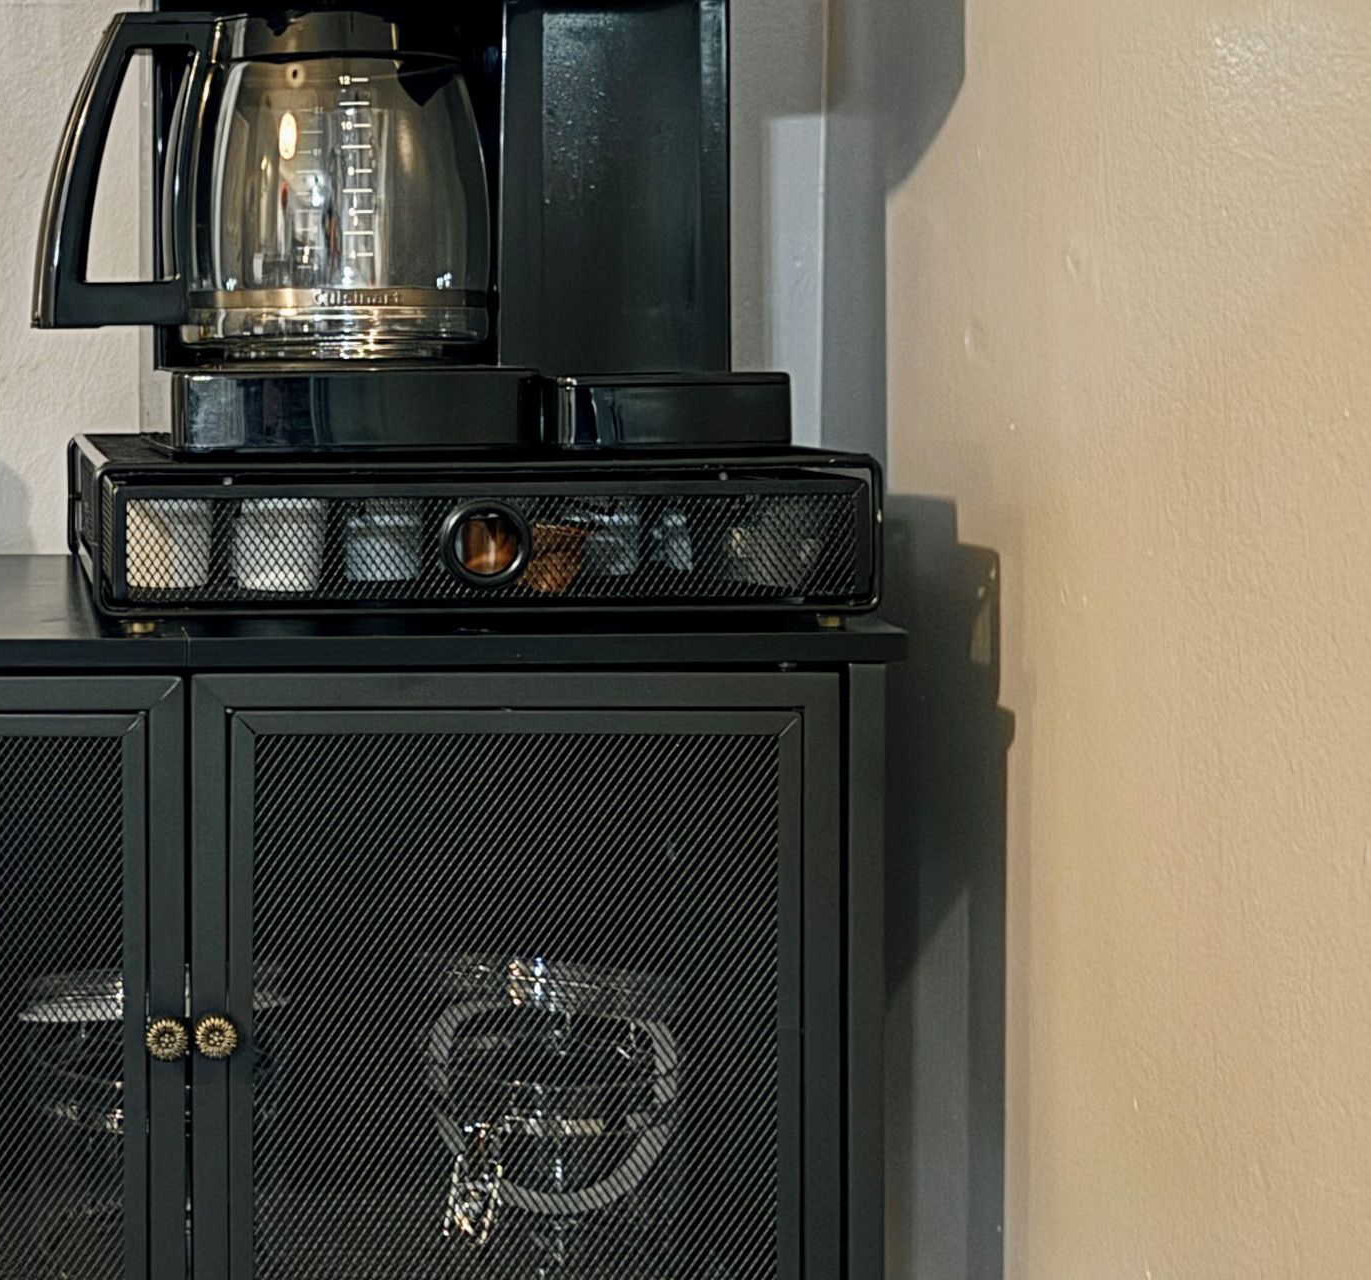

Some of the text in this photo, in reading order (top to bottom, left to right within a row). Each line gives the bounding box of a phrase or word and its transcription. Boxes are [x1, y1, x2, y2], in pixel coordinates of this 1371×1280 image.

[339, 75, 350, 85] 12
[341, 121, 352, 131] 10
[312, 288, 401, 306] Cuisinart
